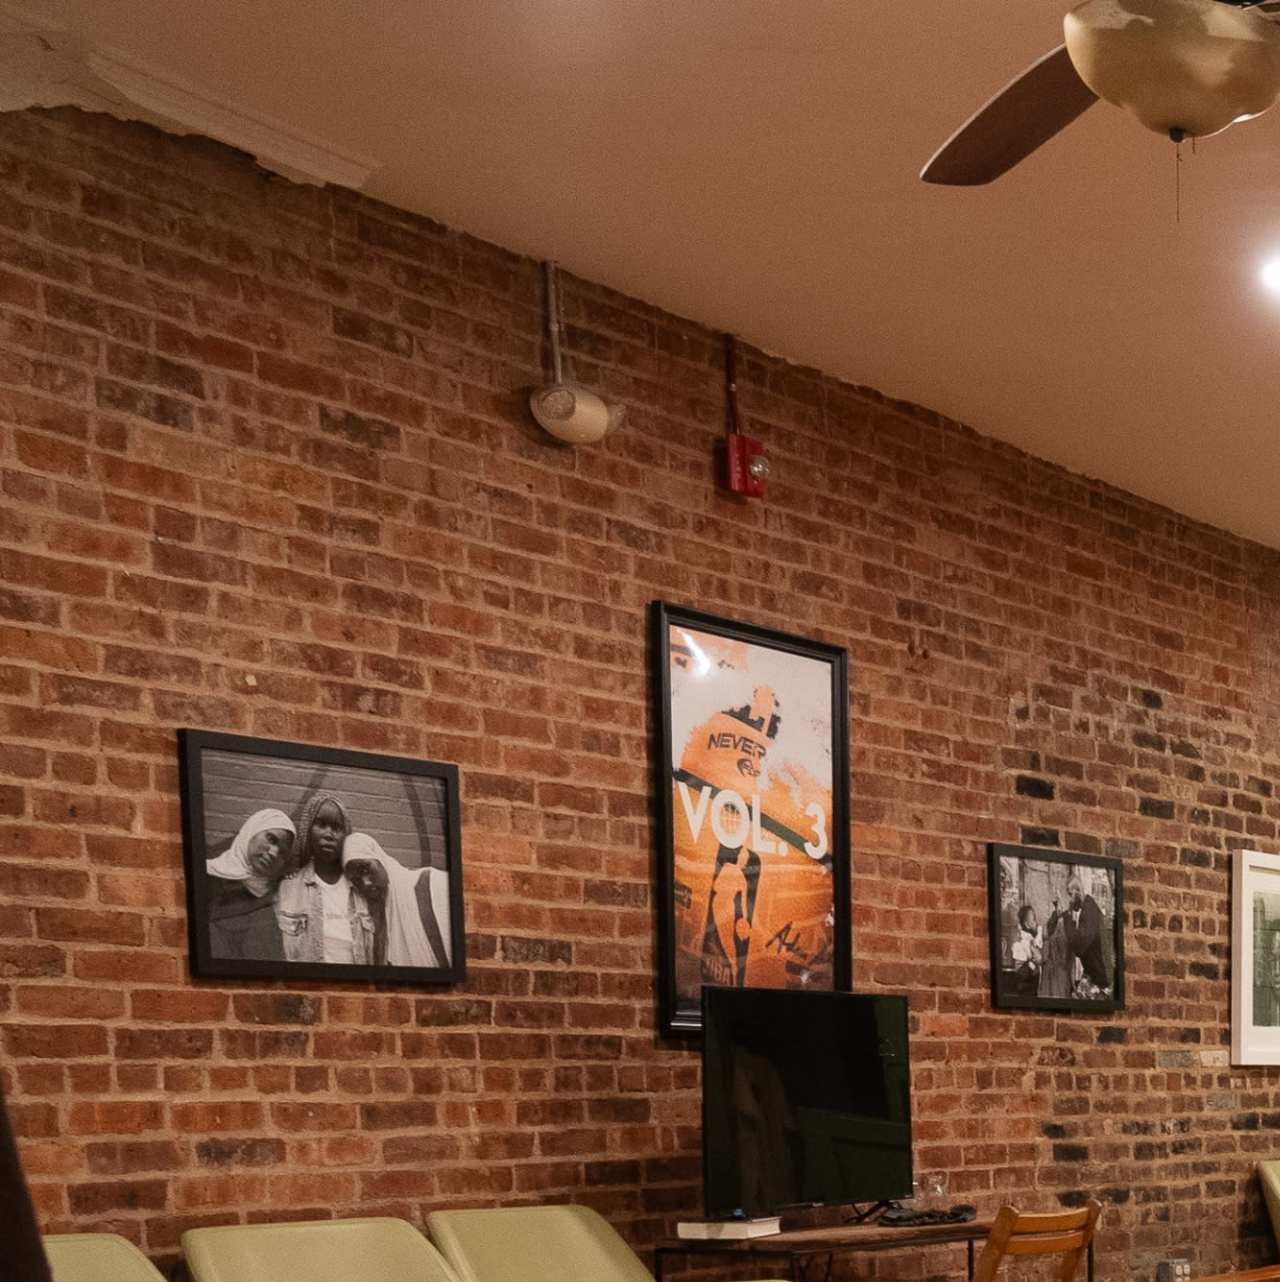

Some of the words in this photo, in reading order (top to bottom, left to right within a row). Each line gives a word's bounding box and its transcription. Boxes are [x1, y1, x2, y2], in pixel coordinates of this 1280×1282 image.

[708, 733, 766, 759] NEVER
[678, 780, 788, 856] VOL.
[804, 801, 828, 859] 3
